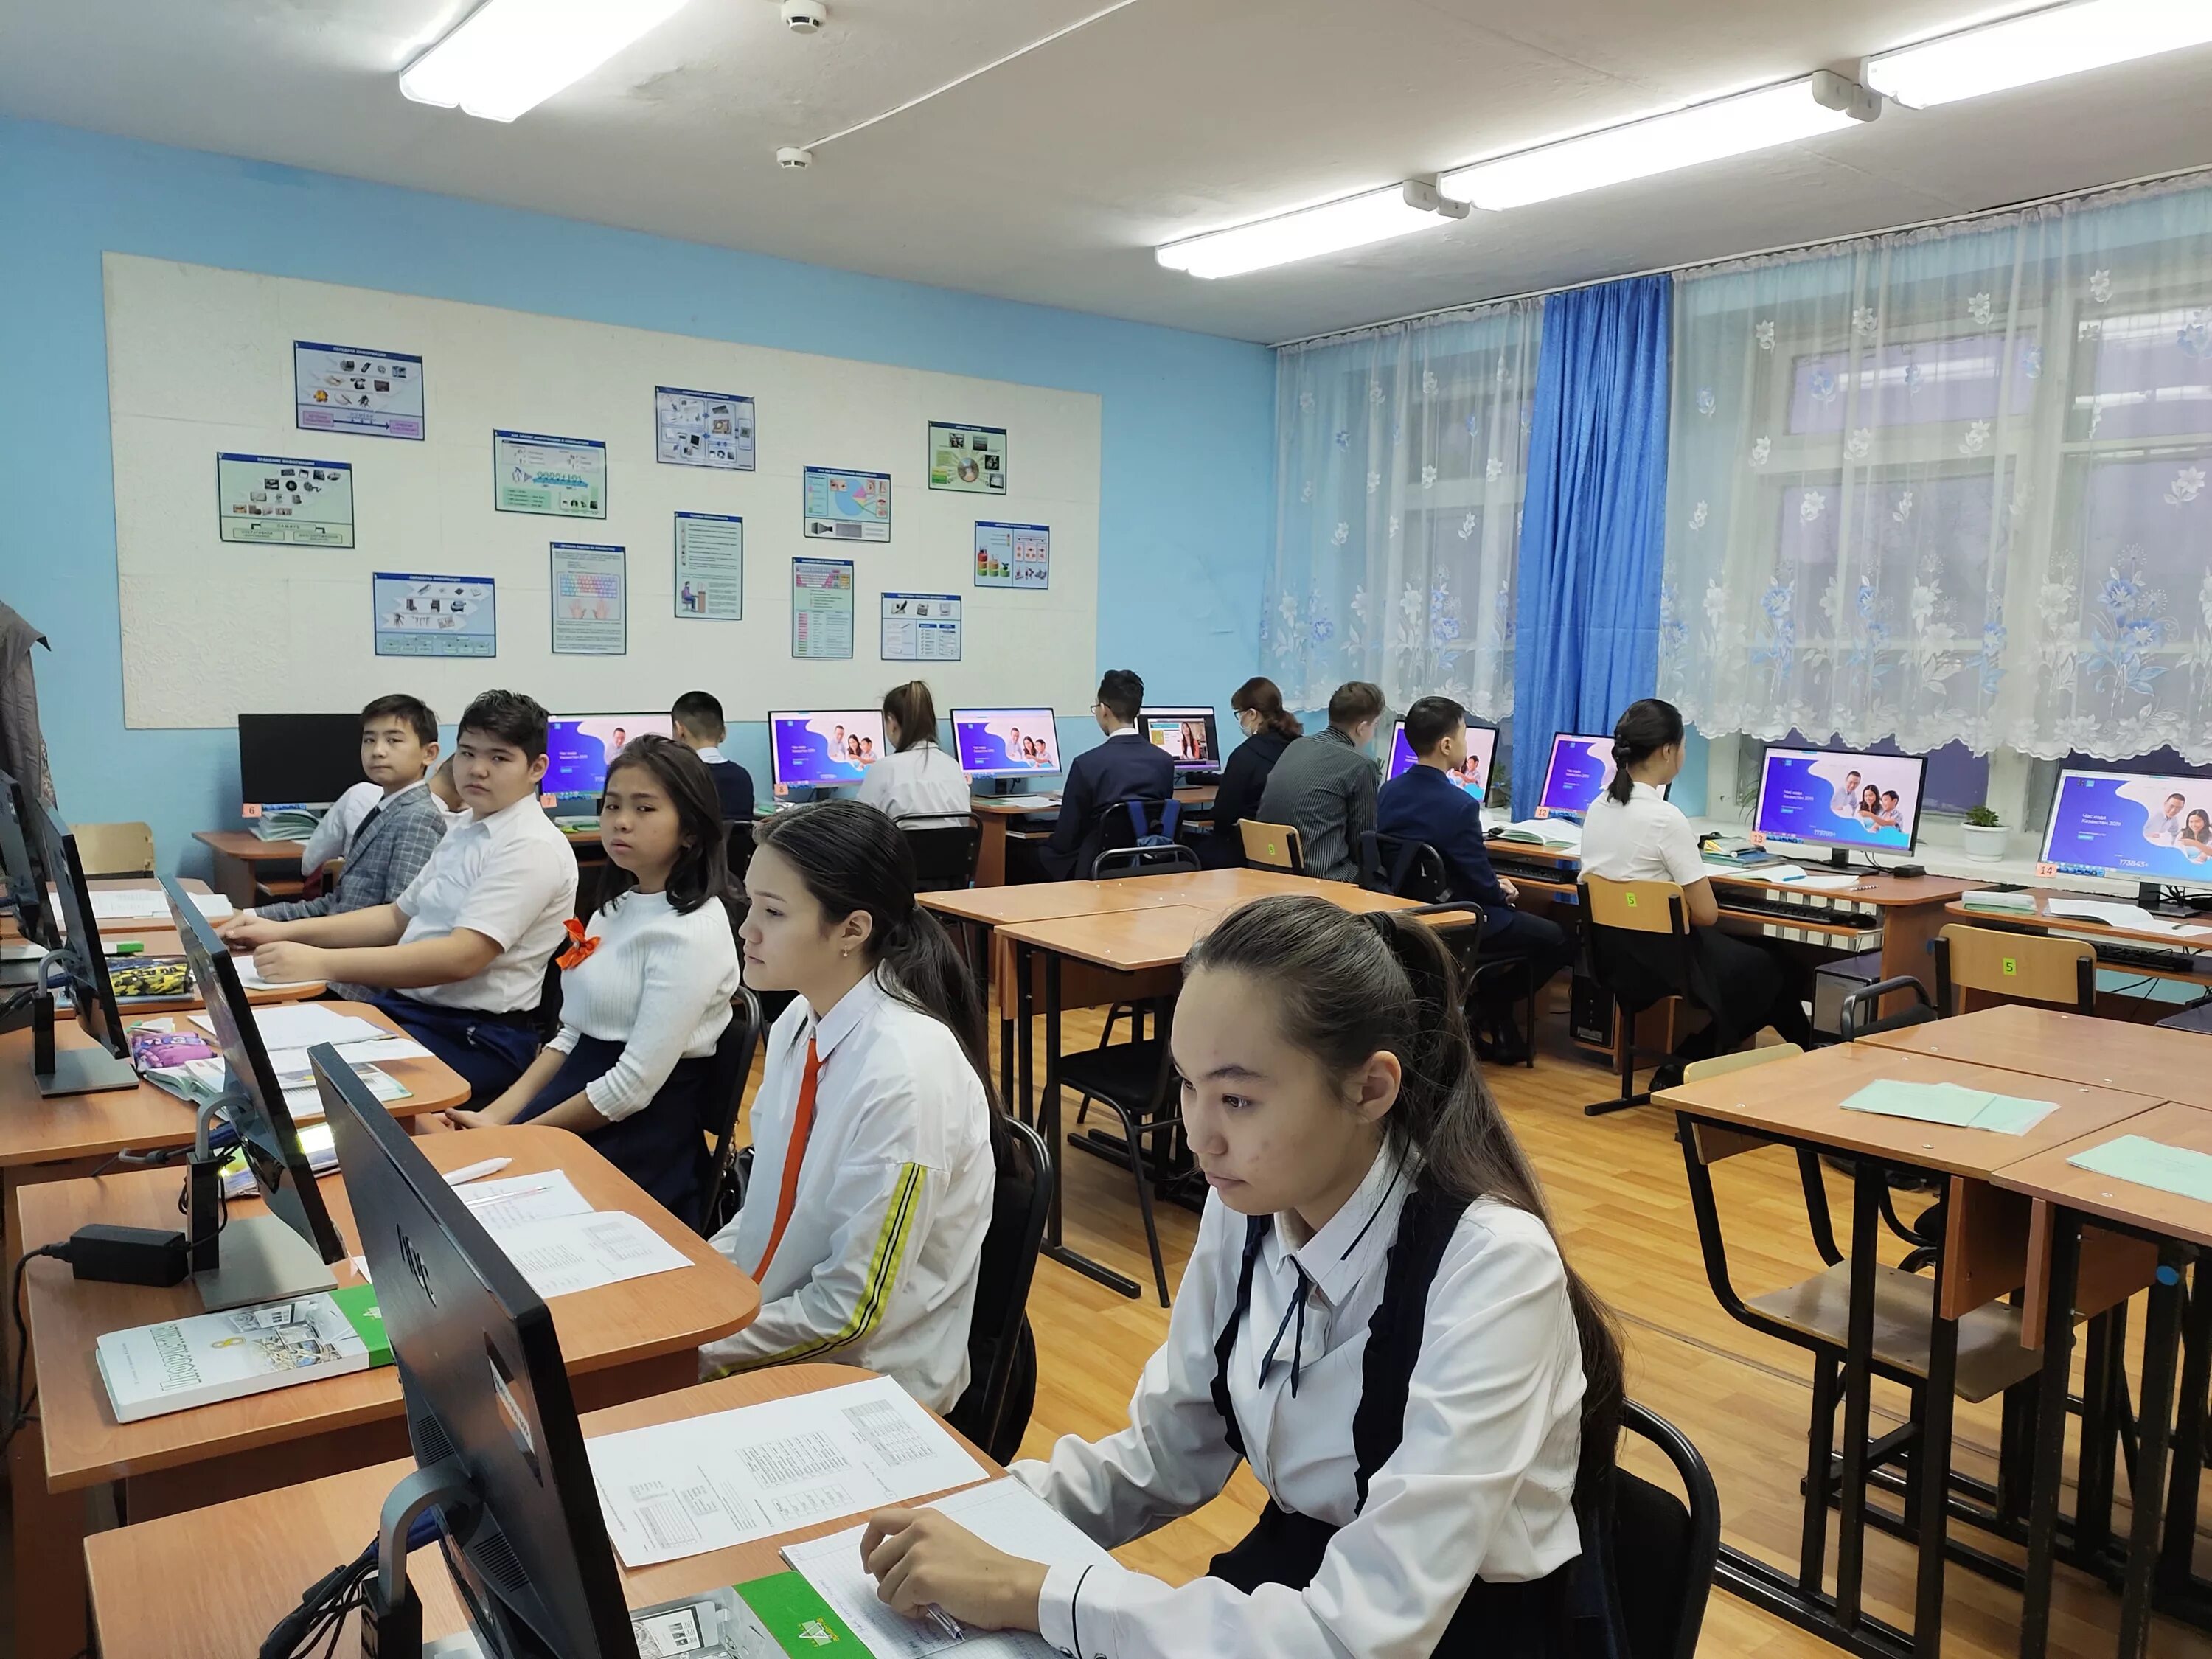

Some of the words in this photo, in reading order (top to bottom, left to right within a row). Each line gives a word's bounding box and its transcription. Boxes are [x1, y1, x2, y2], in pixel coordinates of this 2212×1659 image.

[1753, 835, 1763, 843] 13
[2040, 866, 2053, 875] 14
[1629, 896, 1635, 905] 5
[2006, 962, 2013, 972] 5
